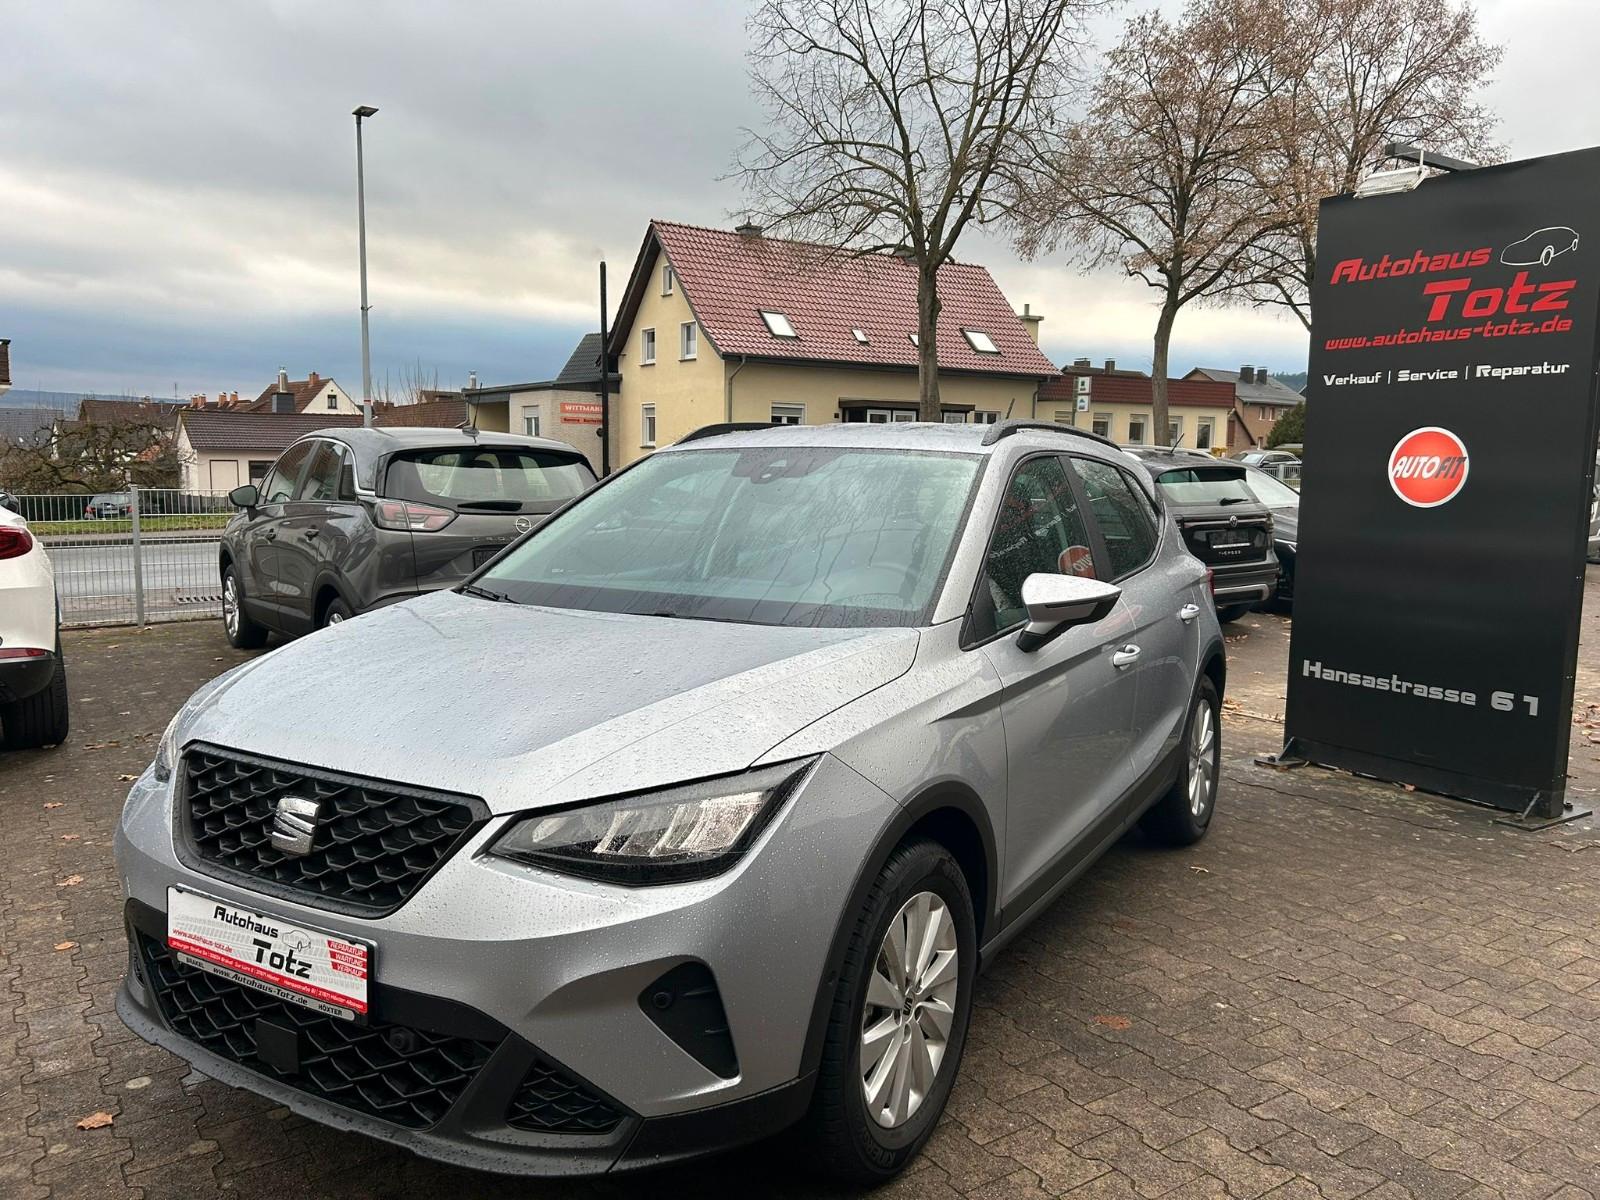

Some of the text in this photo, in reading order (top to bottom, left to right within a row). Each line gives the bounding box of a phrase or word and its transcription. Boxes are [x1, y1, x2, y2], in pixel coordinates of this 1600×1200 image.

[1330, 247, 1493, 285] Autohaus
[1423, 271, 1577, 322] Totz
[1325, 316, 1573, 350] www.autohaus-totz.de
[1324, 361, 1570, 386] Verkauf Service Reparatur
[564, 404, 603, 413] WITTMAN
[1392, 455, 1468, 480] AUTOFIT
[1302, 659, 1477, 706] Hansastrasse
[213, 905, 279, 938] Autohaus
[253, 939, 312, 978] Totz
